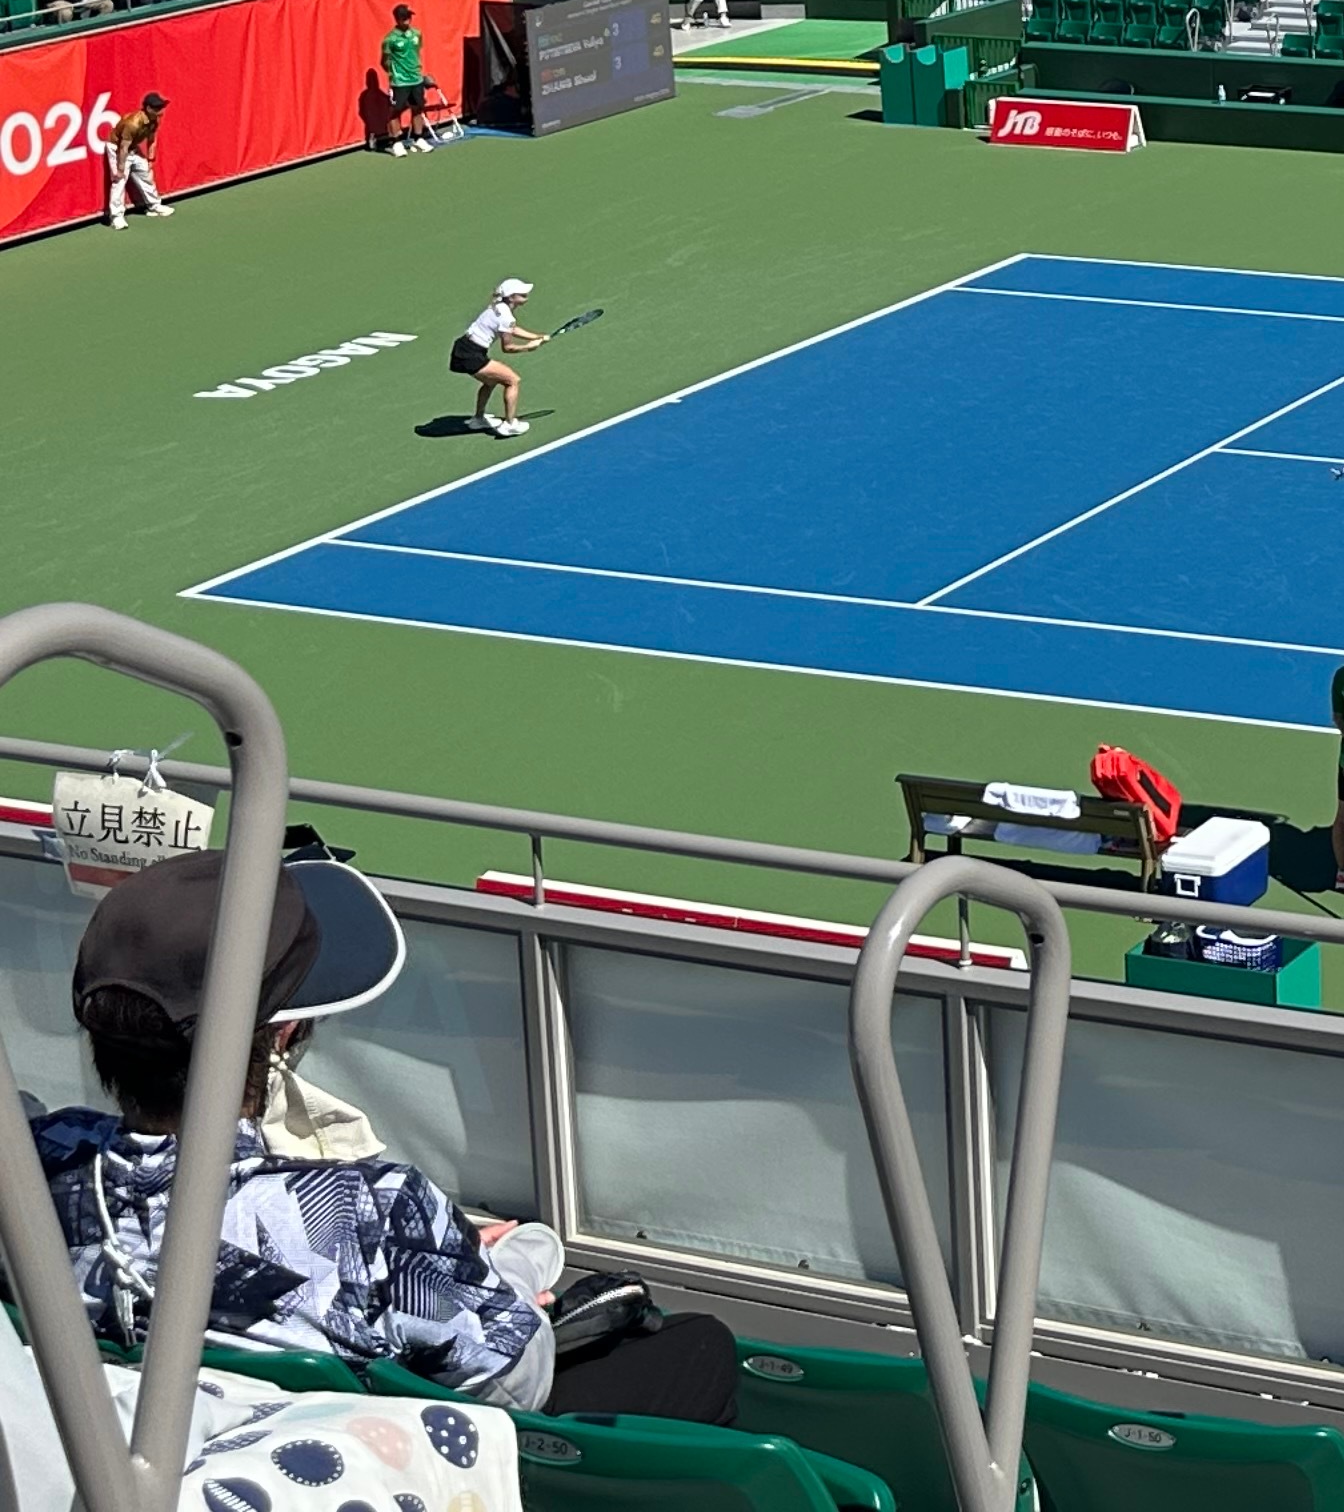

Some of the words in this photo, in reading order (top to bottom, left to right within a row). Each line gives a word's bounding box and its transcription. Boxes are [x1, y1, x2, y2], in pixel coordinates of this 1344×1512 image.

[612, 22, 620, 37] 3
[614, 55, 622, 70] 3
[0, 91, 122, 176] 026
[997, 109, 1043, 138] JTB
[192, 331, 419, 398] NAGOYA
[61, 800, 202, 851] 立見禁止
[69, 844, 89, 860] No
[90, 848, 148, 870] Standing
